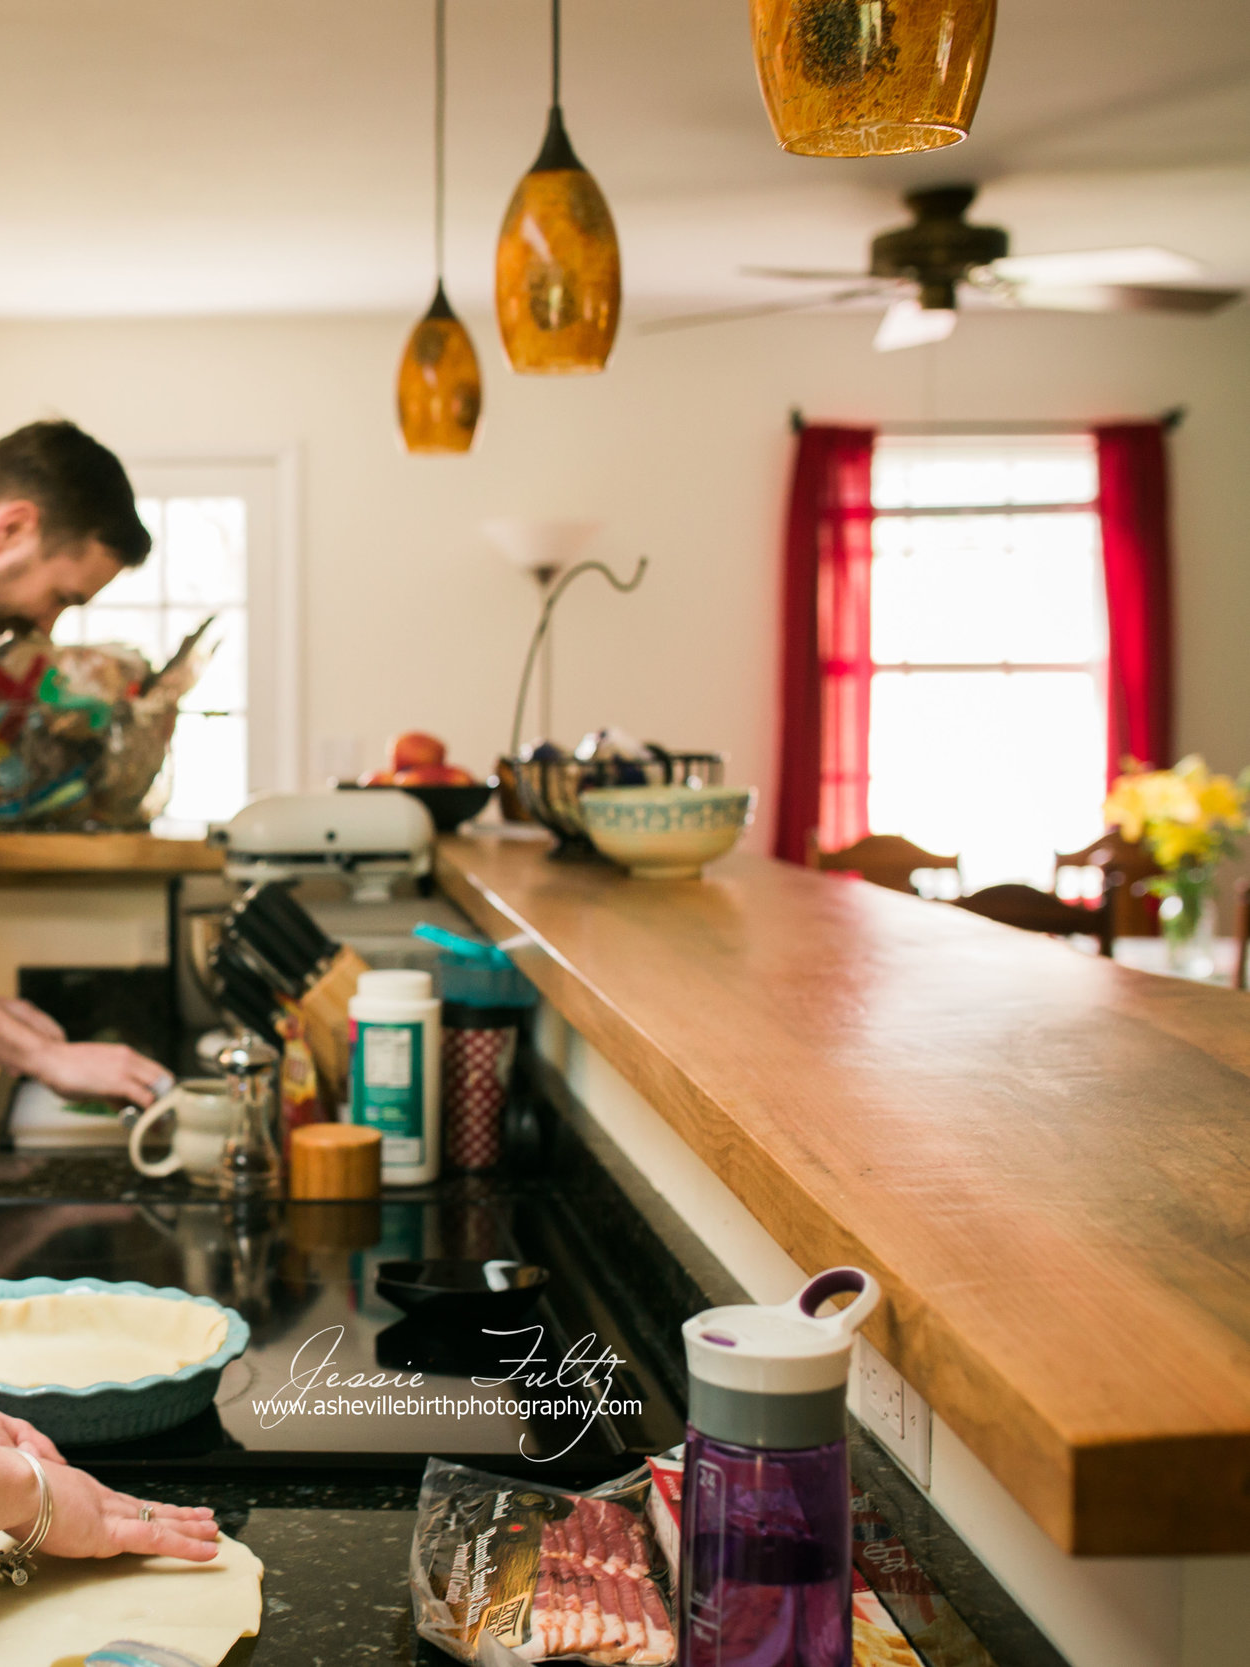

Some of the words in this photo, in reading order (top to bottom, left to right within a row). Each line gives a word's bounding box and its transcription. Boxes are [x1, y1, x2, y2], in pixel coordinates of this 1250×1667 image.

[454, 1540, 472, 1571] Product
[470, 1526, 497, 1575] Naturally
[495, 1599, 520, 1637] EXTRA
